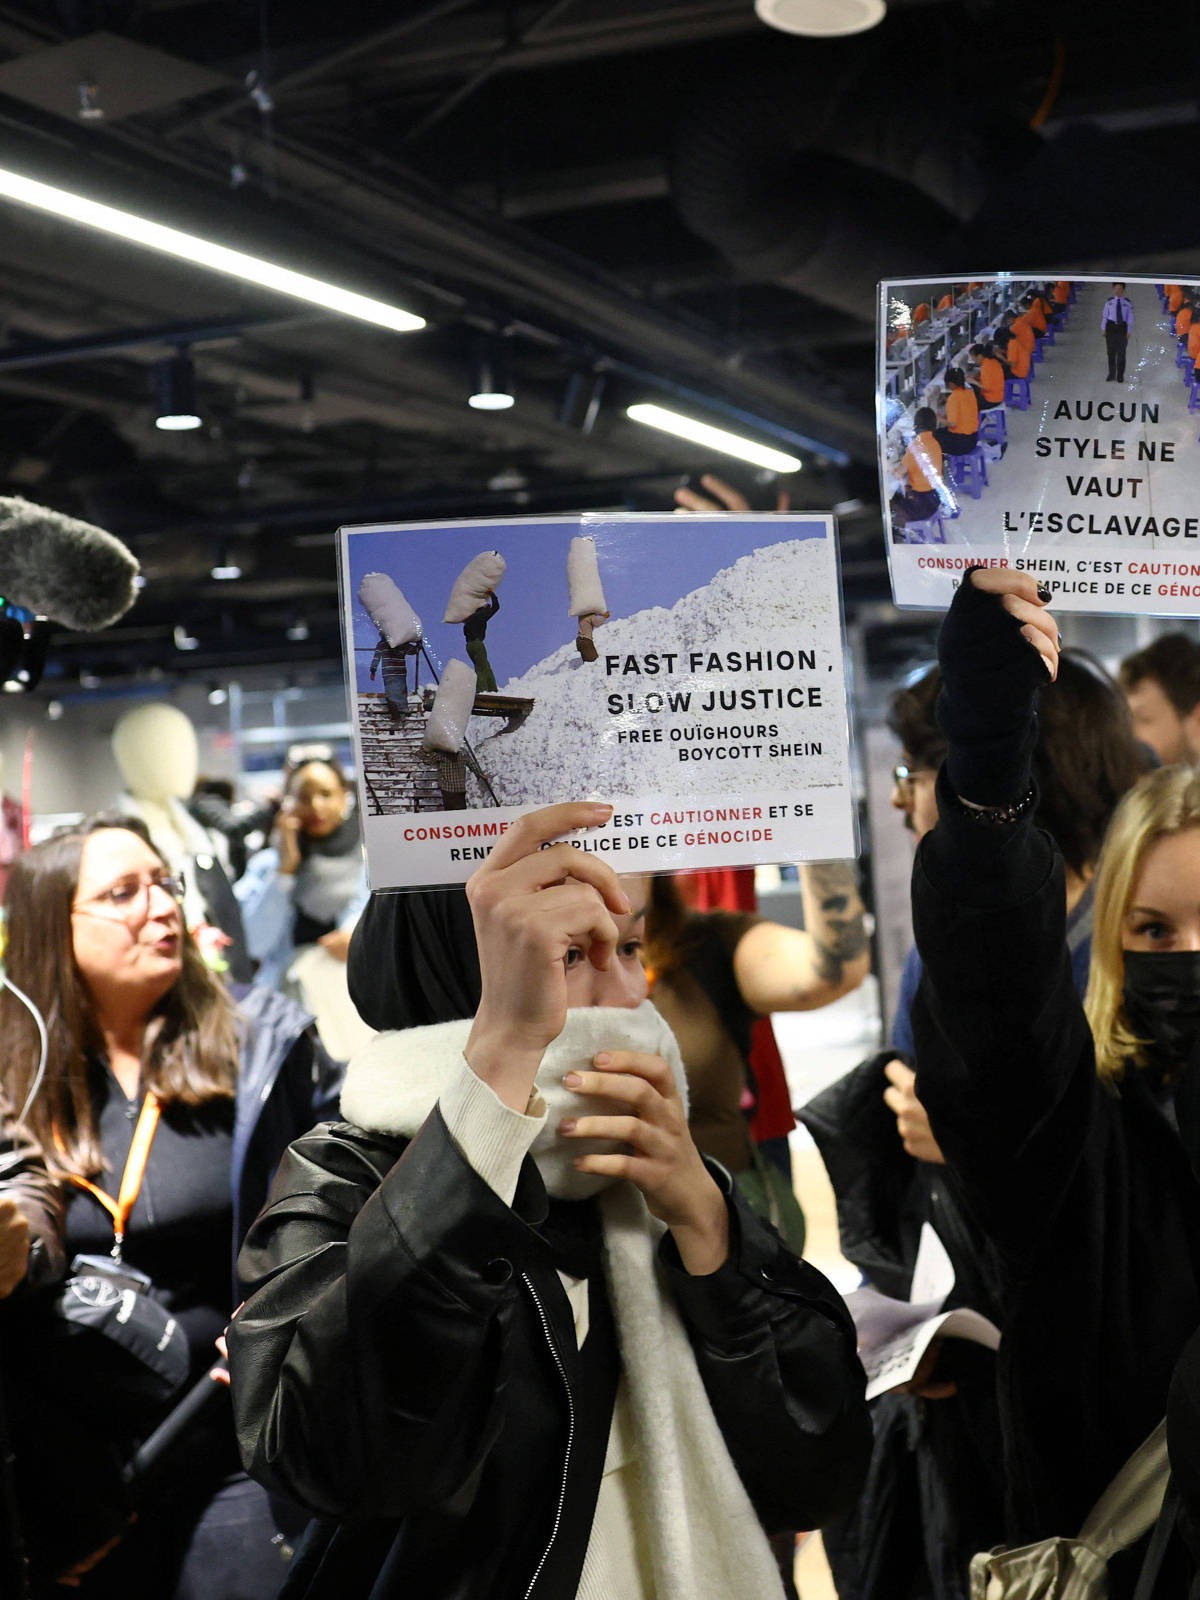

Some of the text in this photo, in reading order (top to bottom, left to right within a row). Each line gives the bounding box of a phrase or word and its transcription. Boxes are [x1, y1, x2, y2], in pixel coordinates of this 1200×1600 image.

[1054, 400, 1159, 423] AUCUN
[1035, 437, 1175, 462] STYLE NE
[1066, 475, 1143, 498] VAUT
[1005, 511, 1199, 538] L'ESCLAVAGE
[1015, 559, 1070, 573] SHEIN,
[1077, 560, 1123, 573] C'EST
[1105, 583, 1125, 594] DE
[1131, 583, 1152, 595] CE
[605, 654, 678, 676] FAST
[701, 687, 823, 711] JUSTICE
[618, 724, 779, 744] FREE OUÏGHOURS
[679, 743, 822, 761] BOYCOTT SHEIN
[404, 822, 513, 841] CONSOMME
[650, 807, 763, 825] CAUTIONNER
[769, 805, 788, 818] ET
[794, 804, 814, 816] SE
[628, 836, 650, 849] DE
[656, 834, 678, 848] CE
[684, 828, 773, 846] GÉNOCIDE
